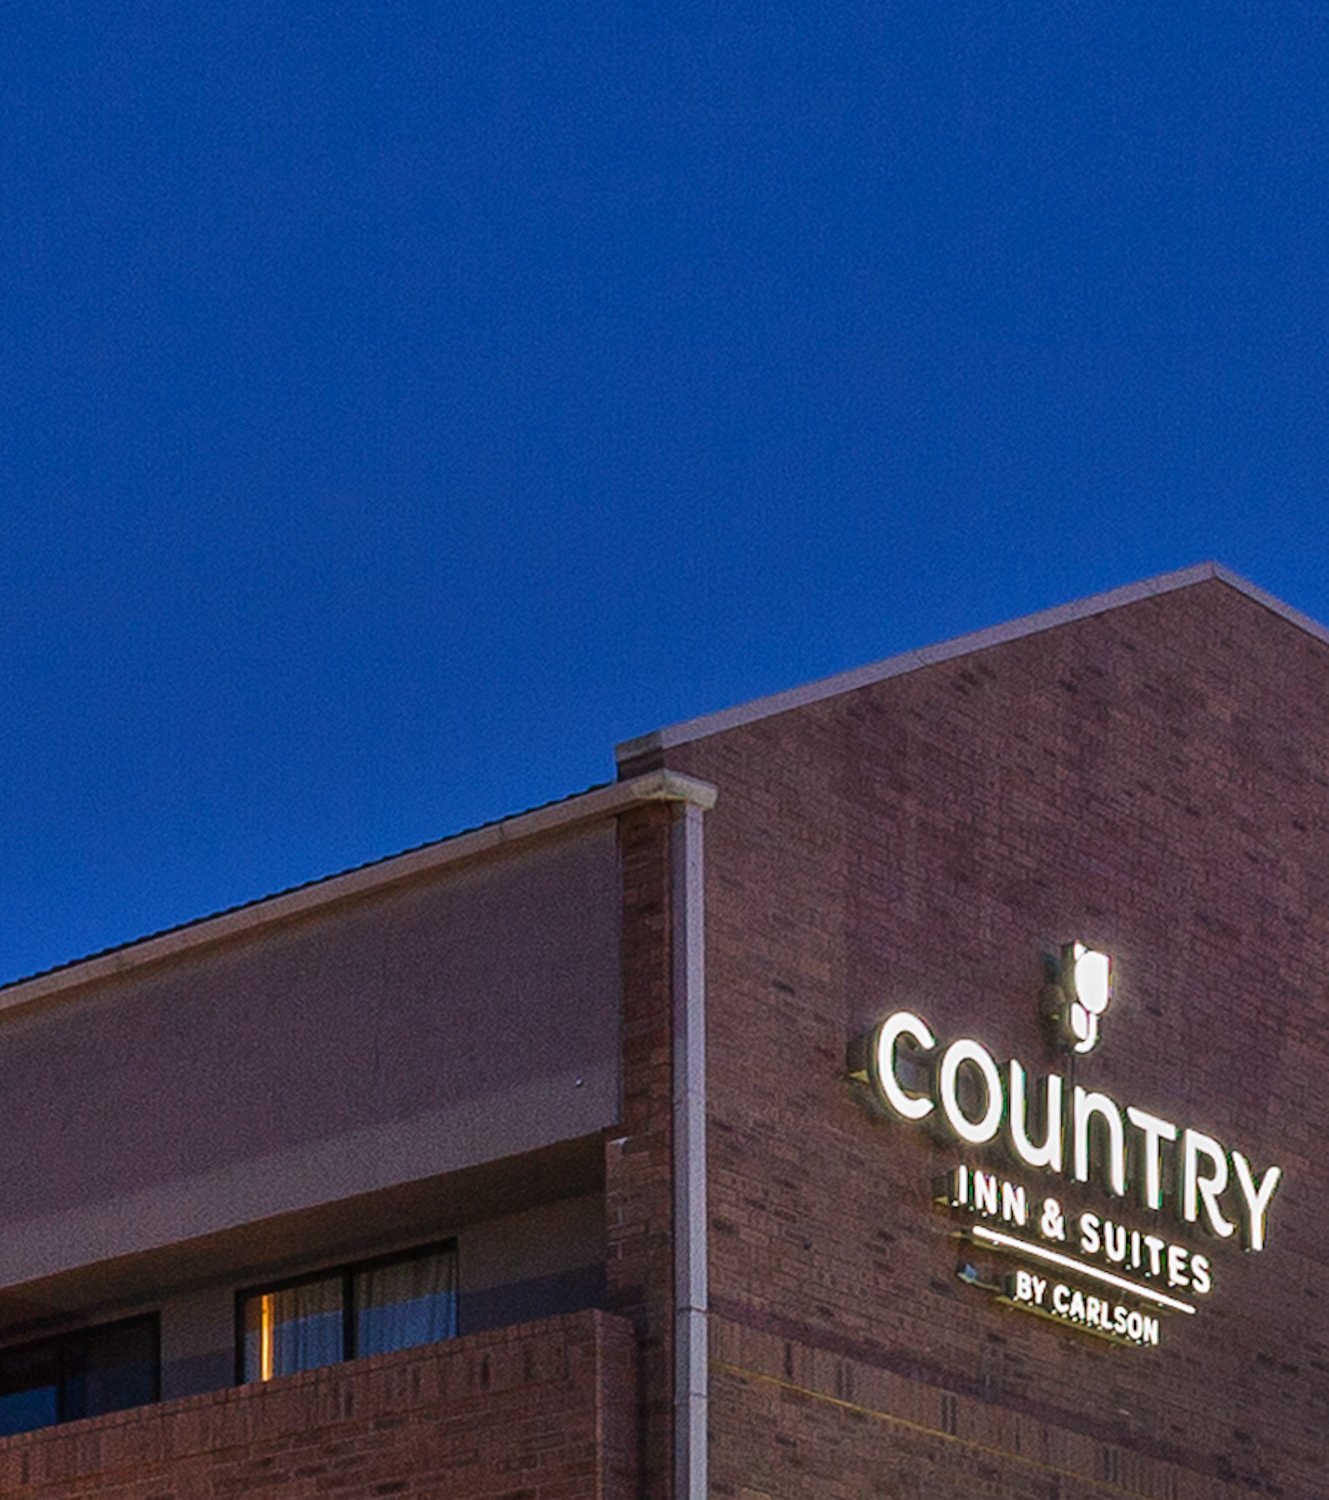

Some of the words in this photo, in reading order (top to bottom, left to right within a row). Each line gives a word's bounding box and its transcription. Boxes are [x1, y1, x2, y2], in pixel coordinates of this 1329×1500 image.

[958, 1165, 1027, 1226] INN
[1041, 1198, 1066, 1241] &
[1079, 1213, 1211, 1294] SUITES
[1015, 1270, 1046, 1301] BY
[1053, 1284, 1159, 1345] CARLSON
